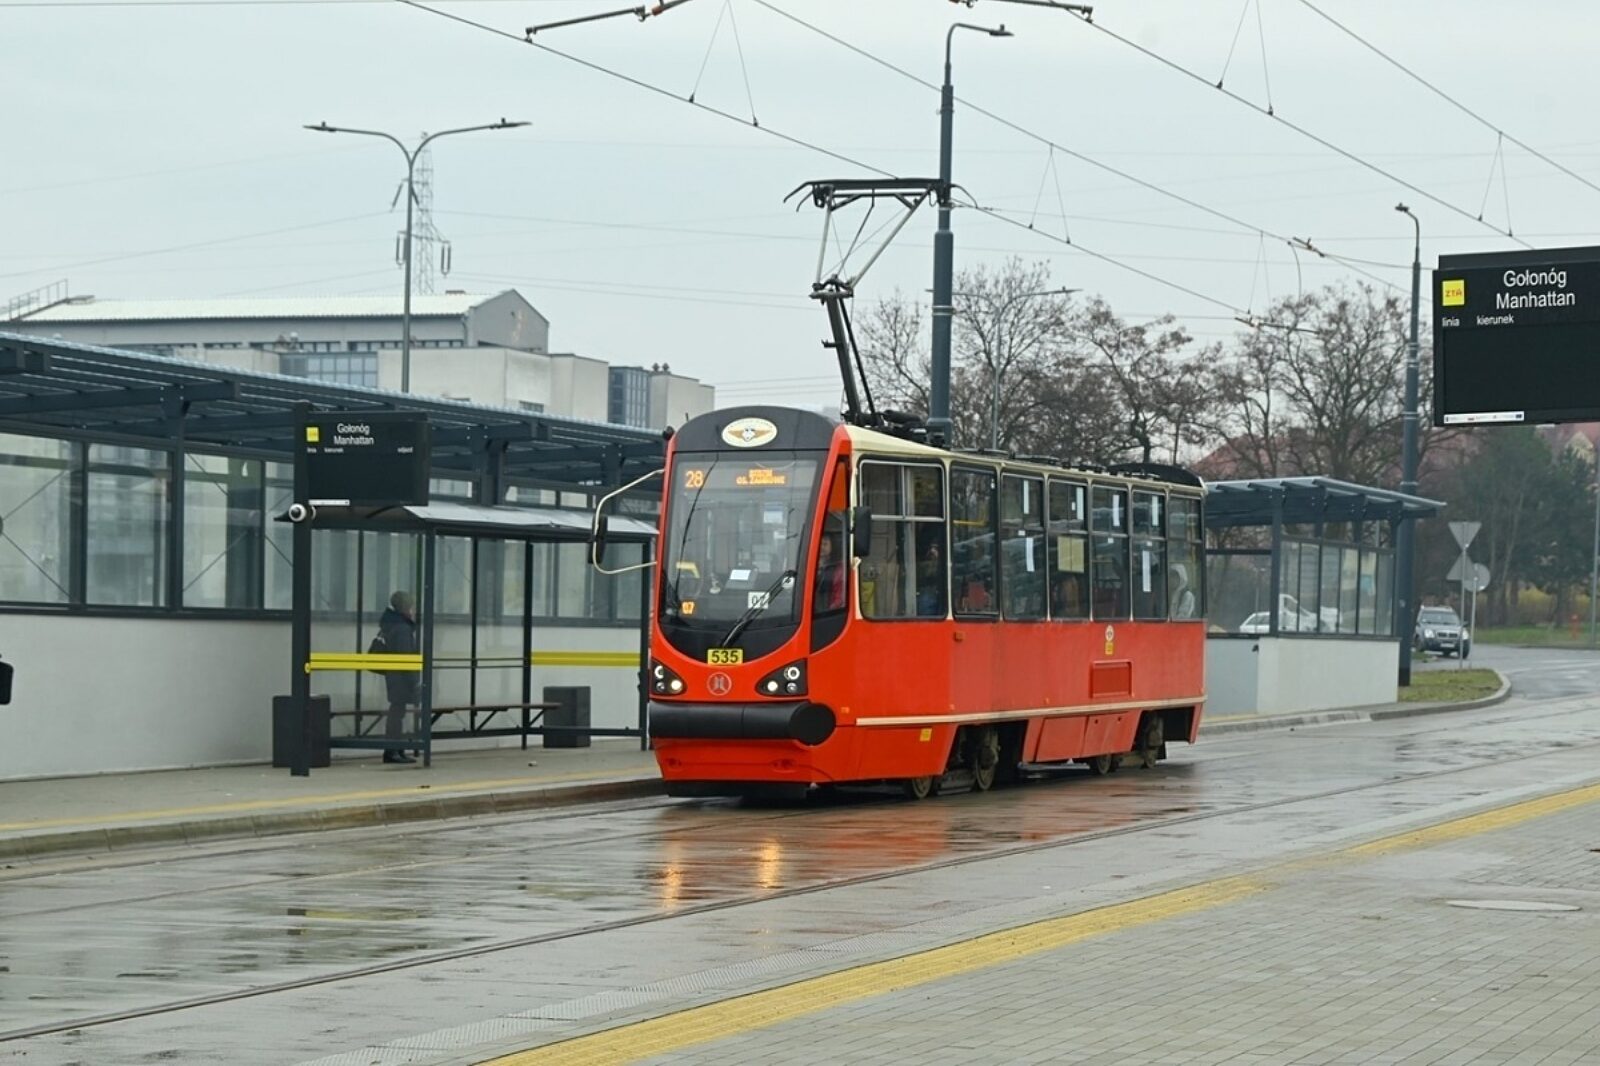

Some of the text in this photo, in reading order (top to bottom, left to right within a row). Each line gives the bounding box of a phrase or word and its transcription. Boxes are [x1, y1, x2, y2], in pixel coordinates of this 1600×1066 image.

[1496, 291, 1576, 310] Manhattan
[1442, 313, 1514, 327] linia kierunek
[333, 435, 375, 446] Manhattan
[684, 470, 704, 488] 28
[711, 650, 739, 664] 535
